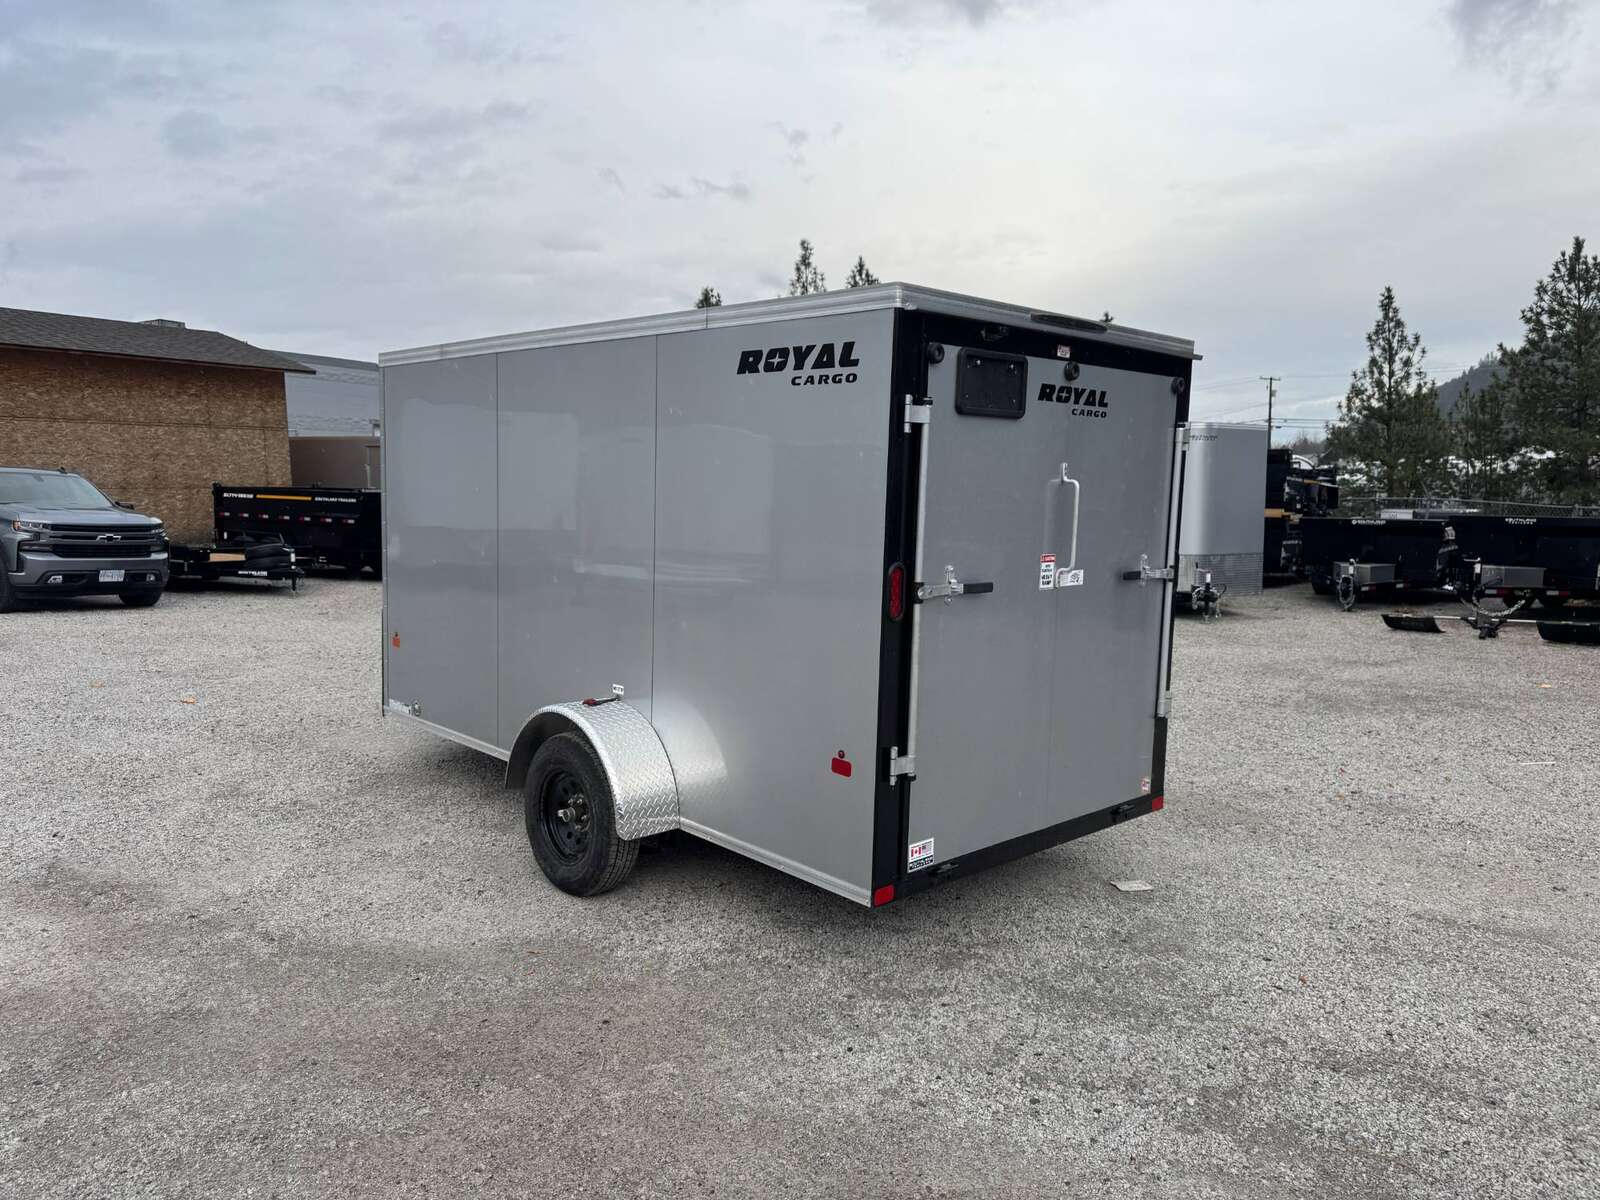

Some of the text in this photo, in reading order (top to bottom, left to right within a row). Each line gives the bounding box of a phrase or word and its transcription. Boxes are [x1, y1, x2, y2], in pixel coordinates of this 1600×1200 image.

[737, 341, 860, 375] ROYAL
[791, 373, 858, 386] CARGO
[1038, 383, 1108, 408] ROYAL
[1072, 408, 1107, 418] CARGO
